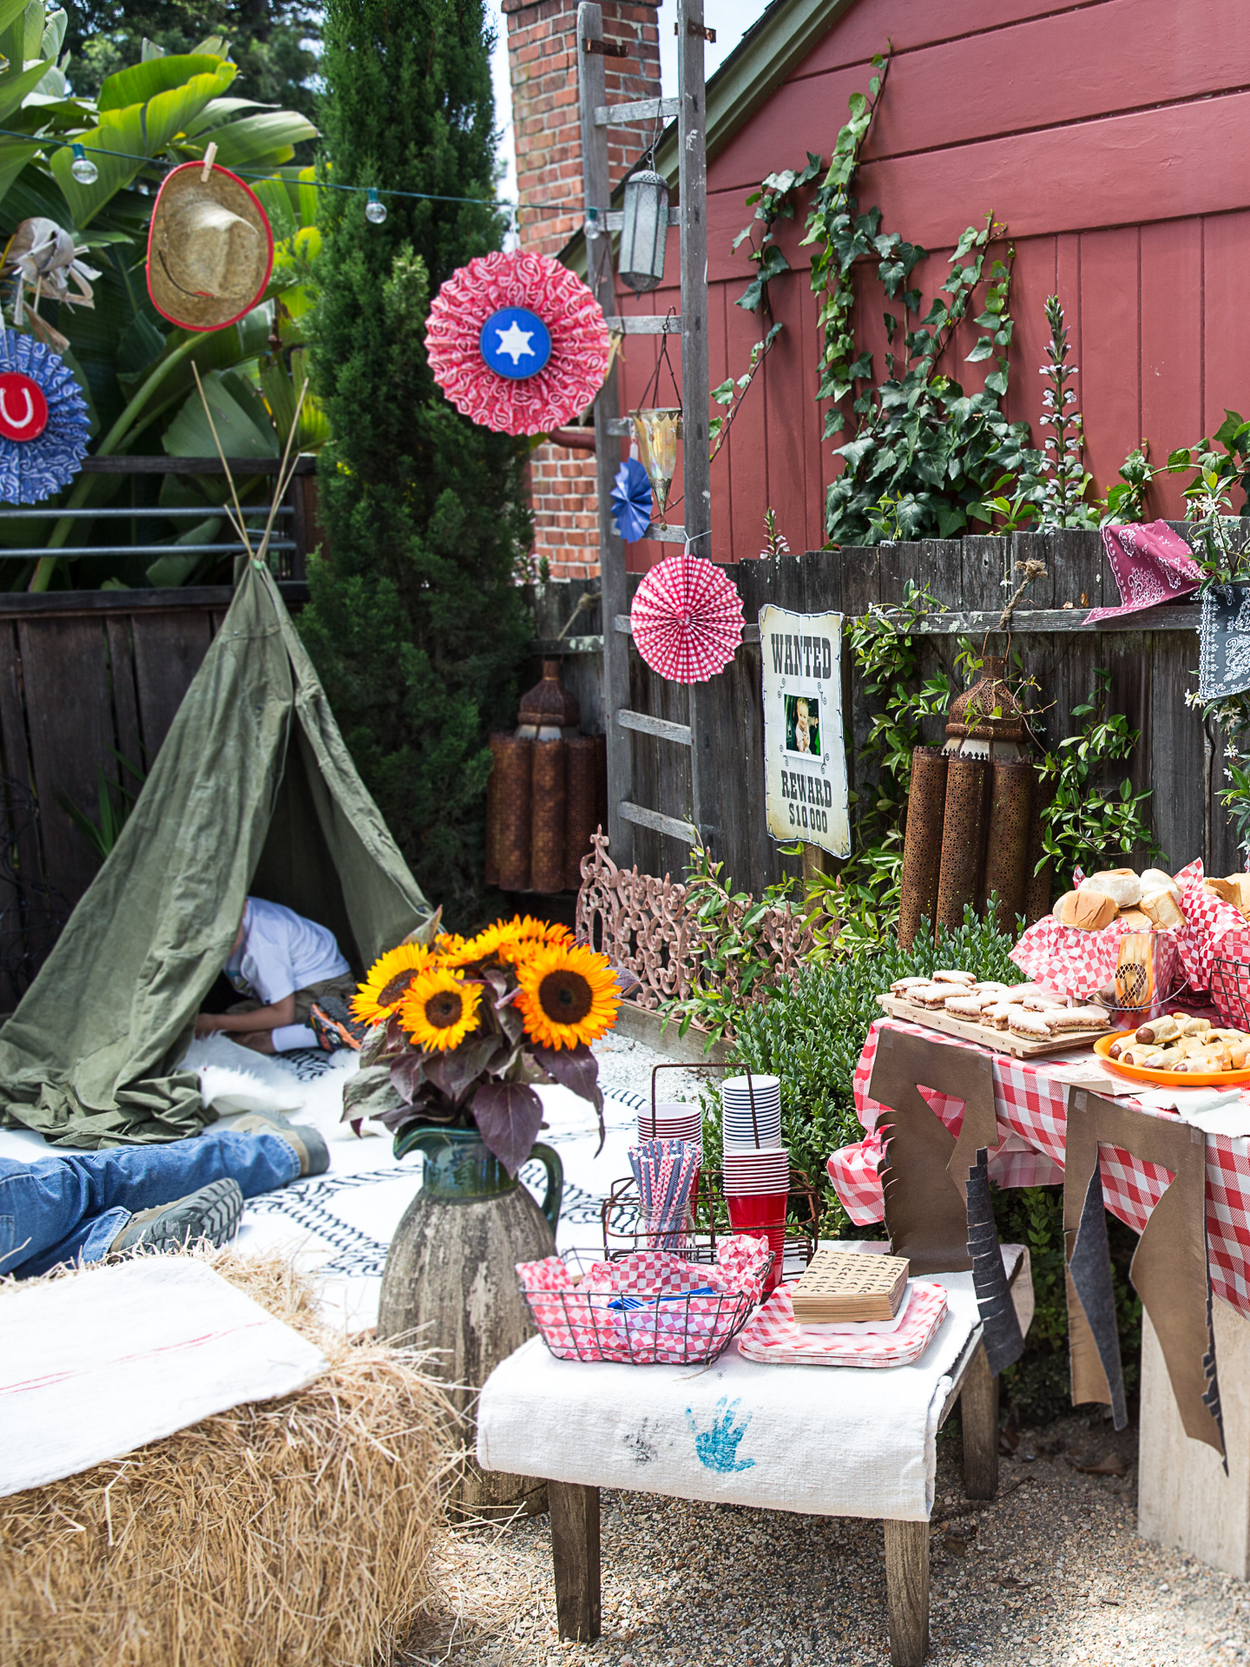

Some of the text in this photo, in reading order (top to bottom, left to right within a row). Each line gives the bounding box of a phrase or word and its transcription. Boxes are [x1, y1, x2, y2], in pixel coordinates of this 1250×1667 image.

[771, 633, 832, 680] WANTED
[780, 769, 833, 809] REWARD
[788, 801, 828, 834] $10000
[1111, 962, 1148, 1013] 2
